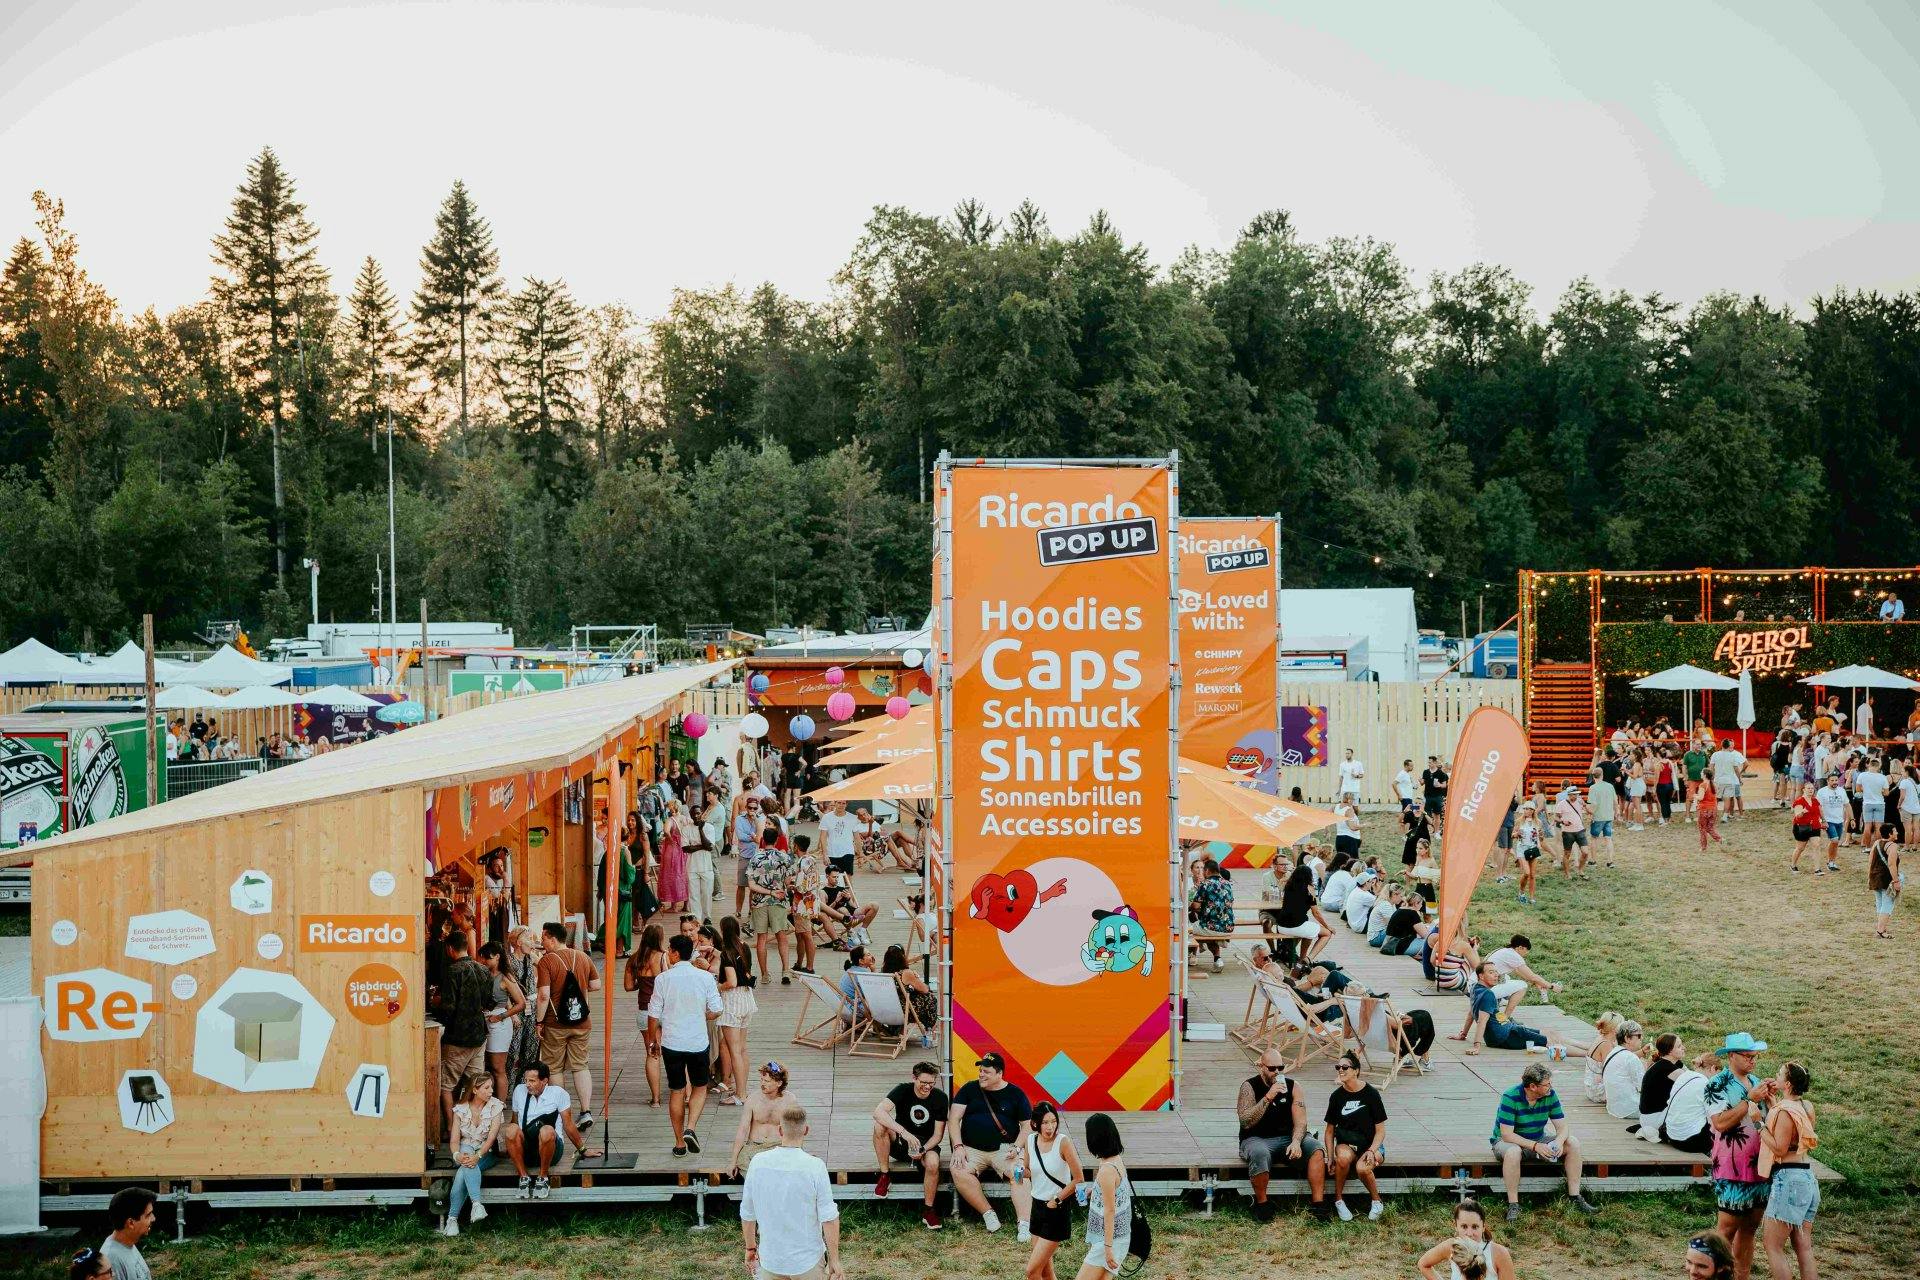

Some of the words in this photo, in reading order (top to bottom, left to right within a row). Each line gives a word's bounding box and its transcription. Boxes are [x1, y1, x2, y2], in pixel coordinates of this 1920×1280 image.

[979, 492, 1142, 528] Ricardo
[1049, 532, 1105, 557] POP
[1110, 527, 1147, 549] UP
[1211, 555, 1242, 569] POP
[1244, 552, 1264, 565] UP
[982, 597, 1142, 630] Hoodies
[1192, 612, 1244, 630] with:
[1203, 650, 1243, 658] CHIMPY
[1714, 626, 1812, 661] APEROL
[981, 638, 1142, 704] Caps
[1195, 683, 1242, 694] Rework
[983, 698, 1141, 728] Schmuck
[981, 736, 1142, 781] Shirts
[75, 746, 118, 821] Heineken
[981, 786, 1142, 807] Sonnenbrillen
[1461, 750, 1500, 821] Ricardo
[981, 811, 1142, 836] Accessoires
[309, 921, 407, 944] Ricardo
[349, 981, 402, 991] Siebdruck
[57, 980, 163, 1031] Re-
